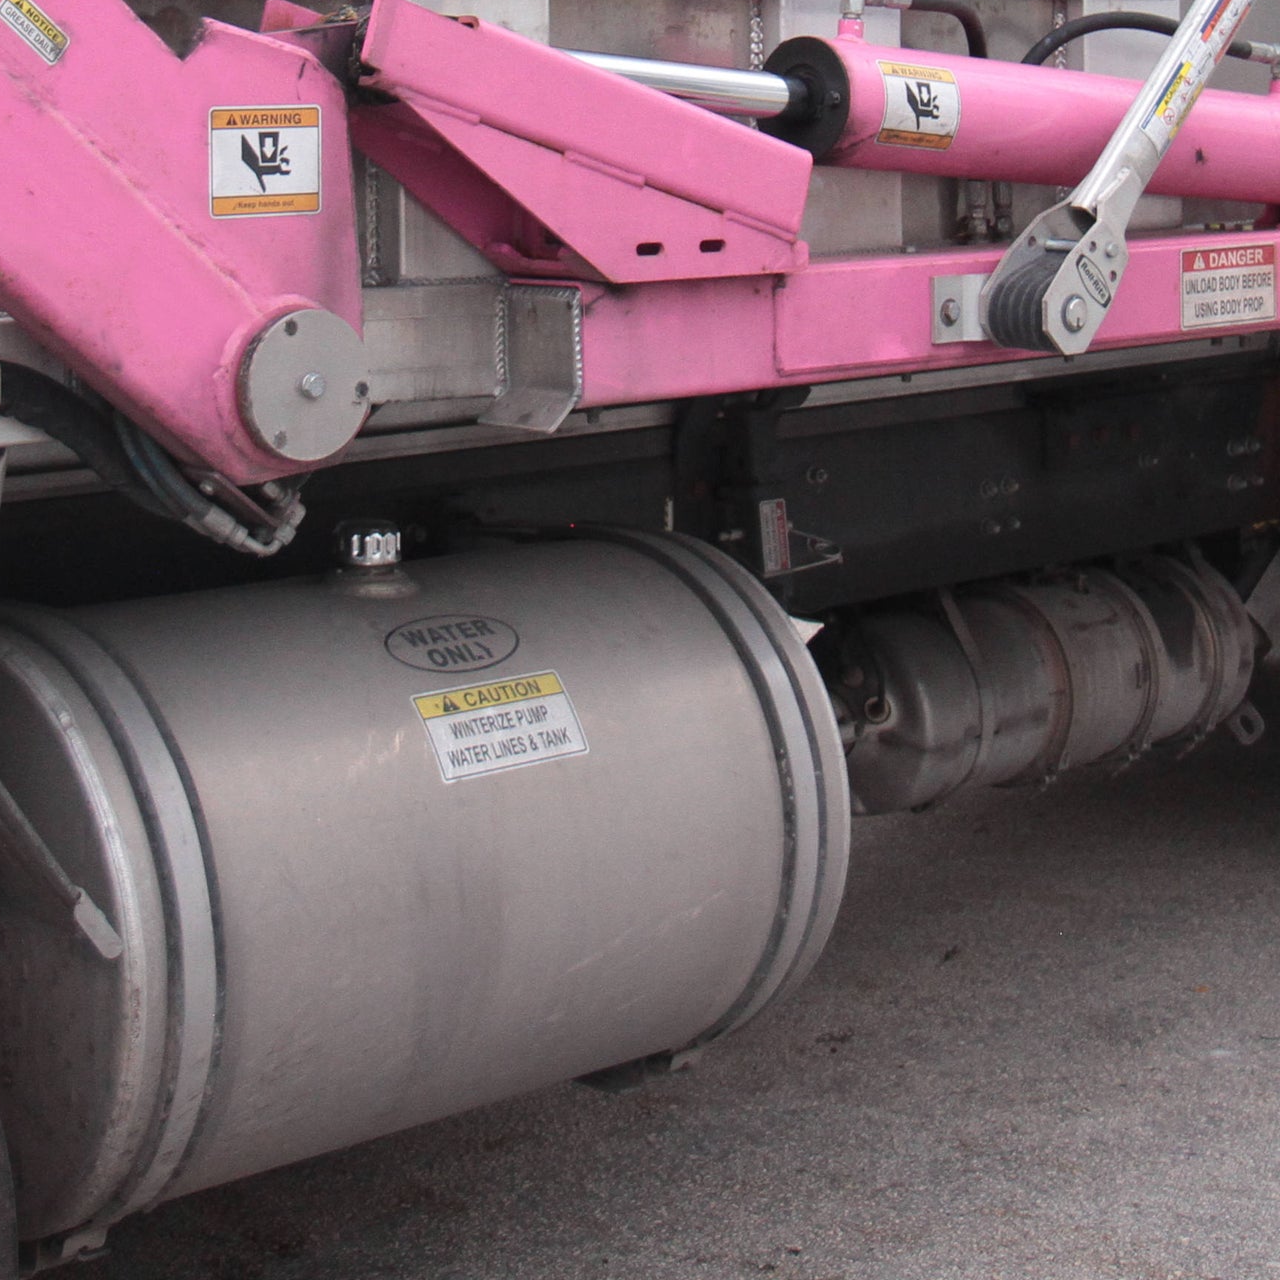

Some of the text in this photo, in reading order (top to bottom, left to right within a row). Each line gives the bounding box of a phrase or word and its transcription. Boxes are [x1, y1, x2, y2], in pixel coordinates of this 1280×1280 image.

[4, 6, 56, 56] GREASE DAILY
[25, 7, 59, 41] NOTICE
[240, 113, 302, 125] WARNING
[1209, 249, 1264, 267] DANGER
[1185, 272, 1272, 295] UNLOAD BODY BEFORE
[1194, 296, 1264, 318] USING BODY PROP
[400, 619, 495, 648] WATER
[427, 641, 494, 667] ONLY
[464, 679, 542, 708] CAUTION
[449, 705, 548, 740] WINTERIZE PUMP
[447, 727, 572, 769] WATER LINES & TANK
